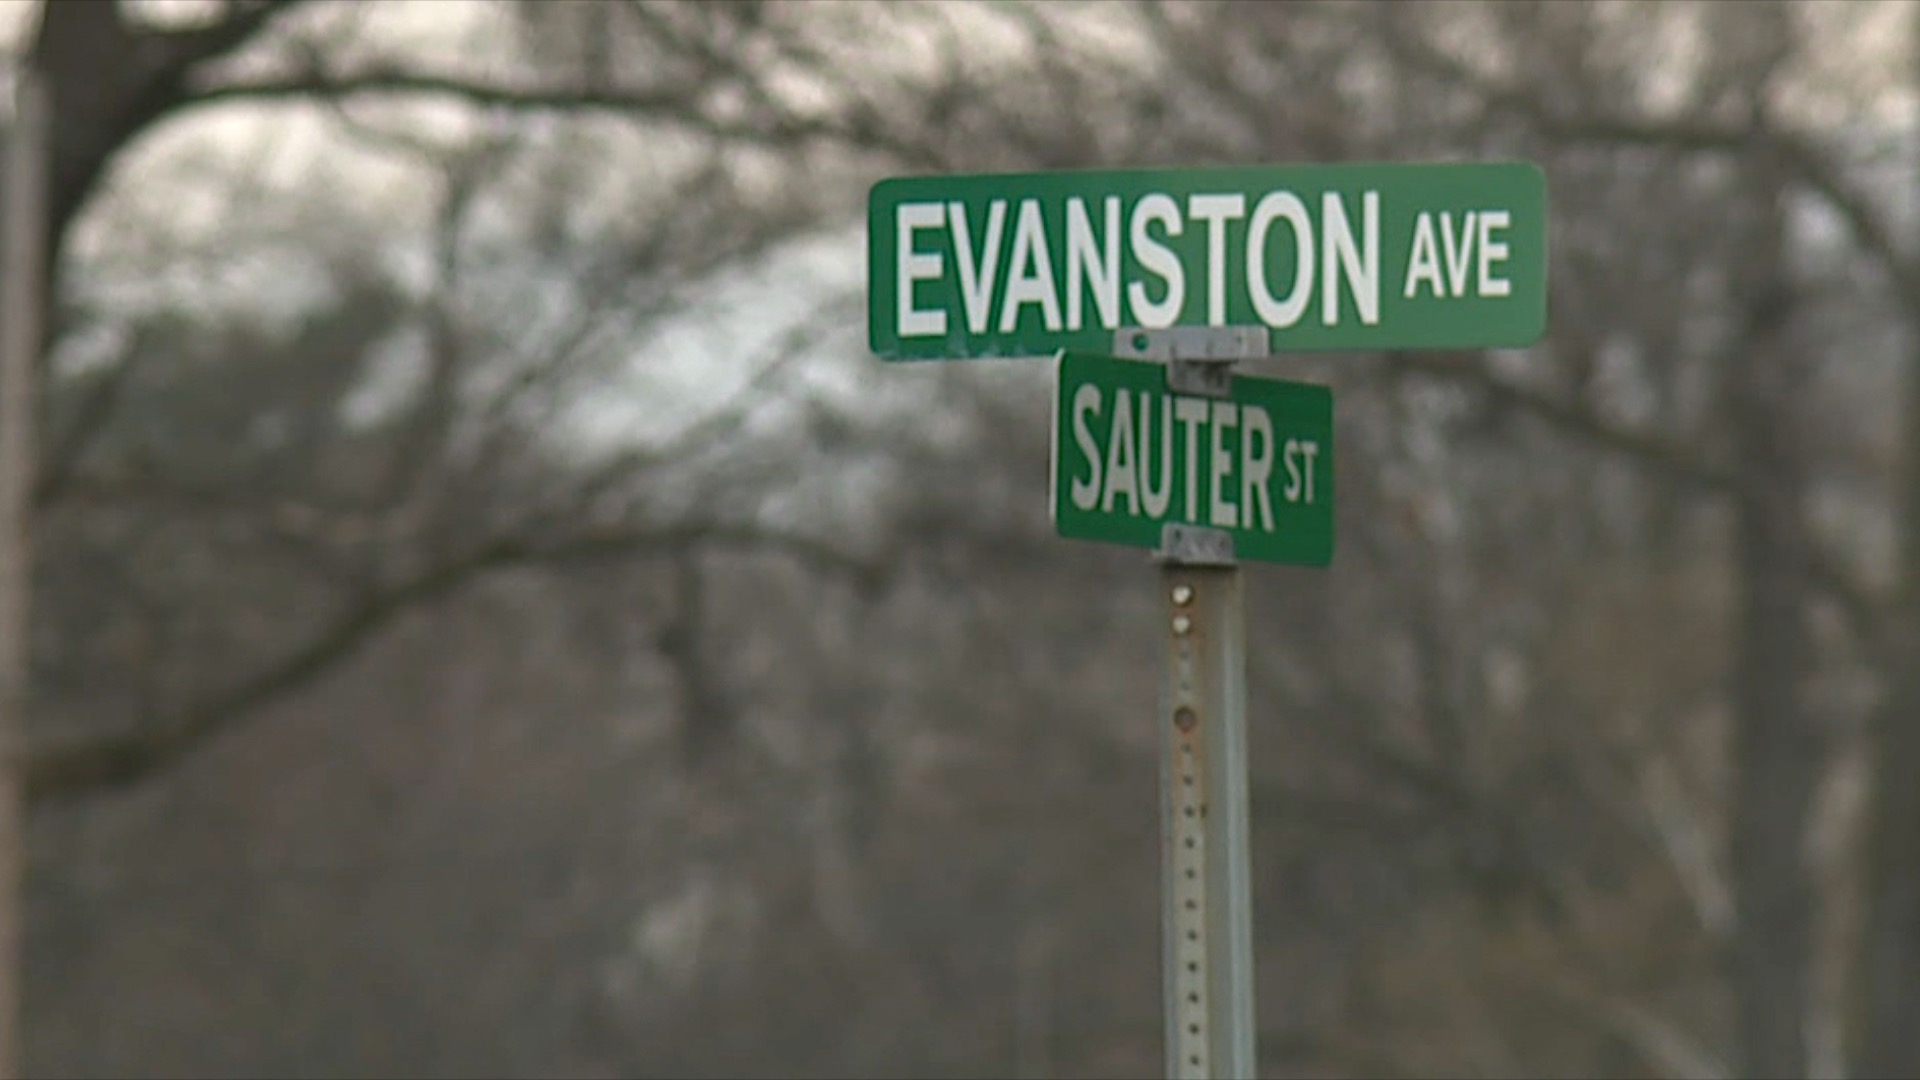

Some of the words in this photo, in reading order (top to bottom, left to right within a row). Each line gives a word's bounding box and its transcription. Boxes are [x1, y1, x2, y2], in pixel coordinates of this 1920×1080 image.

[897, 190, 1380, 336] EVANSTON
[1404, 211, 1511, 298] AVE
[1071, 384, 1274, 531] SAUTER
[1284, 440, 1318, 504] ST
